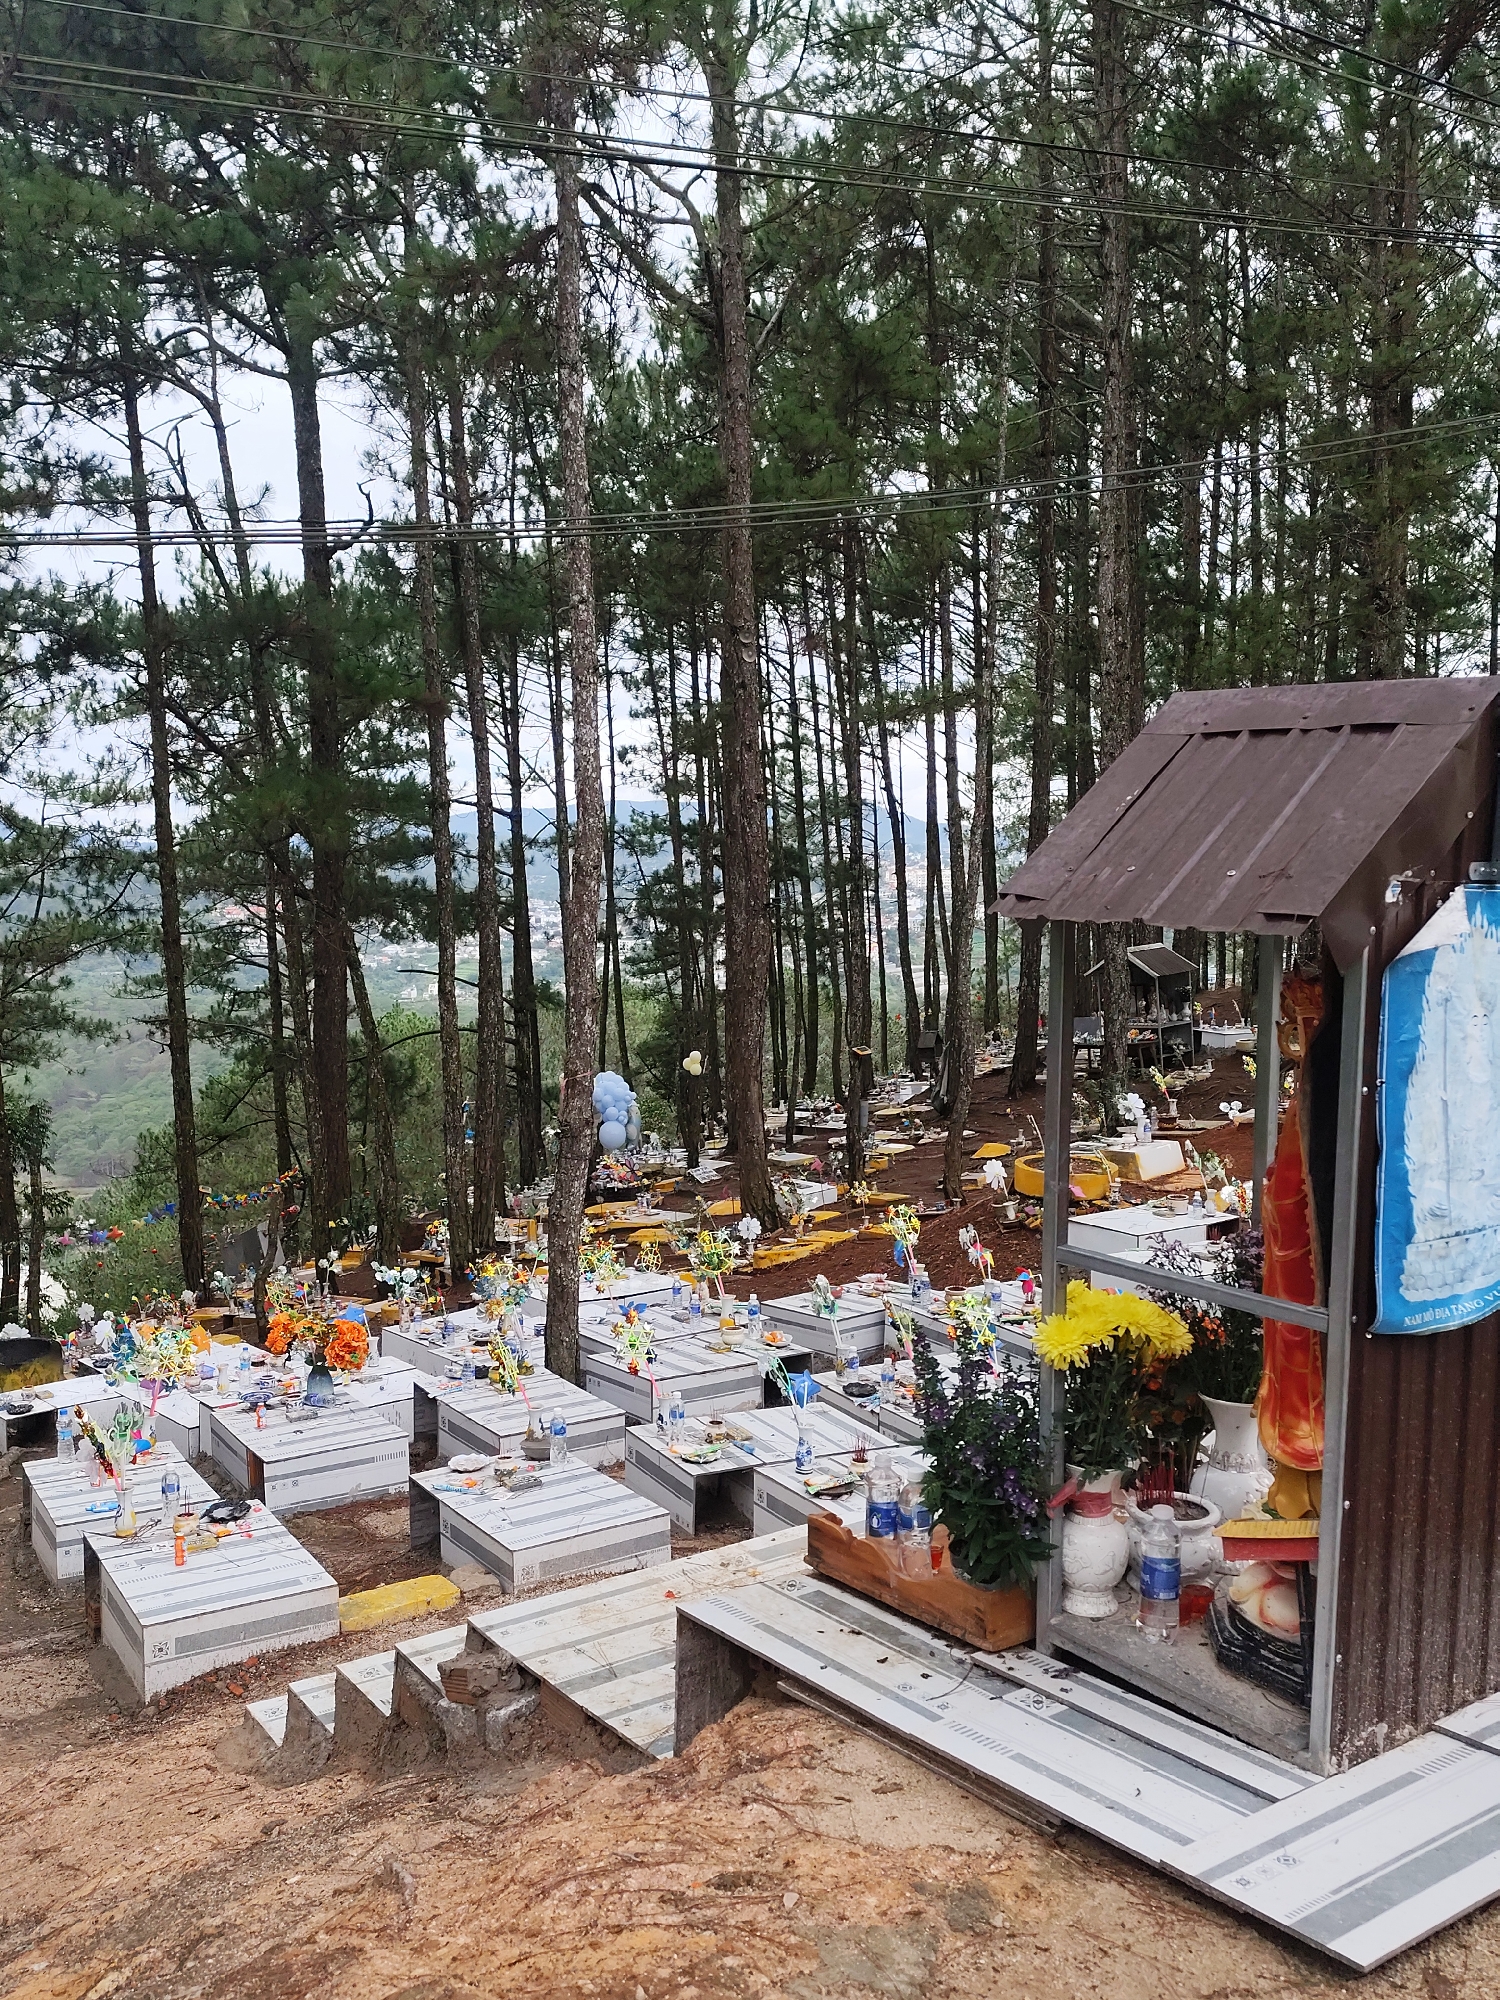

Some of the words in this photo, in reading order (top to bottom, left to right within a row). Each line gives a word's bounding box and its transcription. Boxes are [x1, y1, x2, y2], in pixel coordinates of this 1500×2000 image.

[1403, 1313, 1423, 1327] NAM
[1435, 1307, 1451, 1320] ĐỊA
[1450, 1298, 1485, 1315] TẠNG
